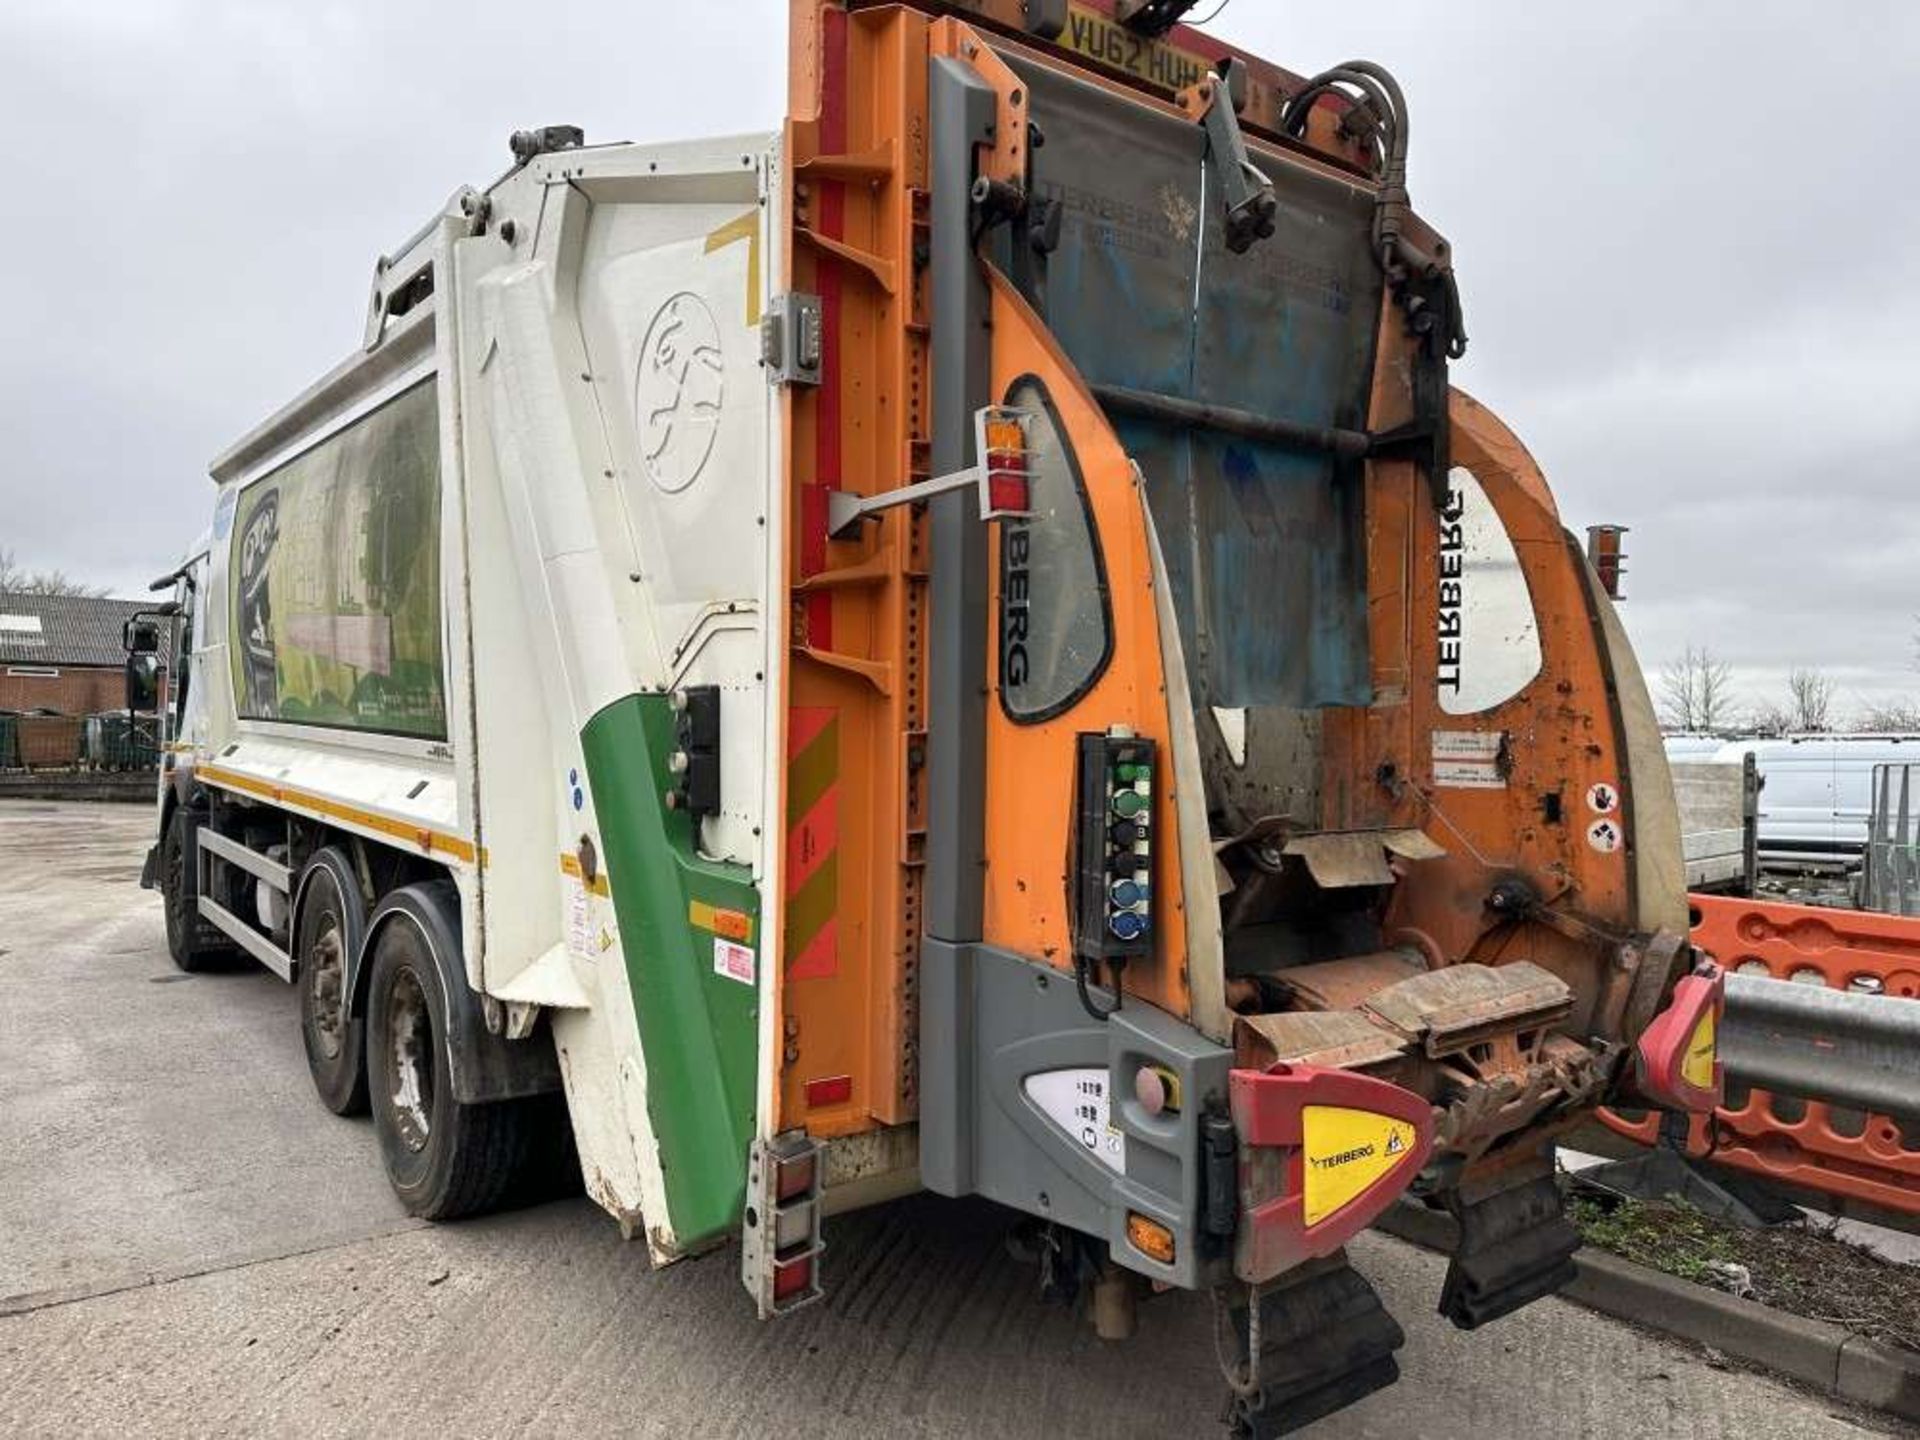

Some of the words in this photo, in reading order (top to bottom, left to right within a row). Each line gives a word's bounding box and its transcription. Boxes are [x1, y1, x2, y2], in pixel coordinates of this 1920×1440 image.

[1070, 12, 1140, 71] VU62
[1151, 43, 1199, 89] HUH
[1008, 529, 1030, 686] BERG
[1320, 1142, 1376, 1169] TERBERG
